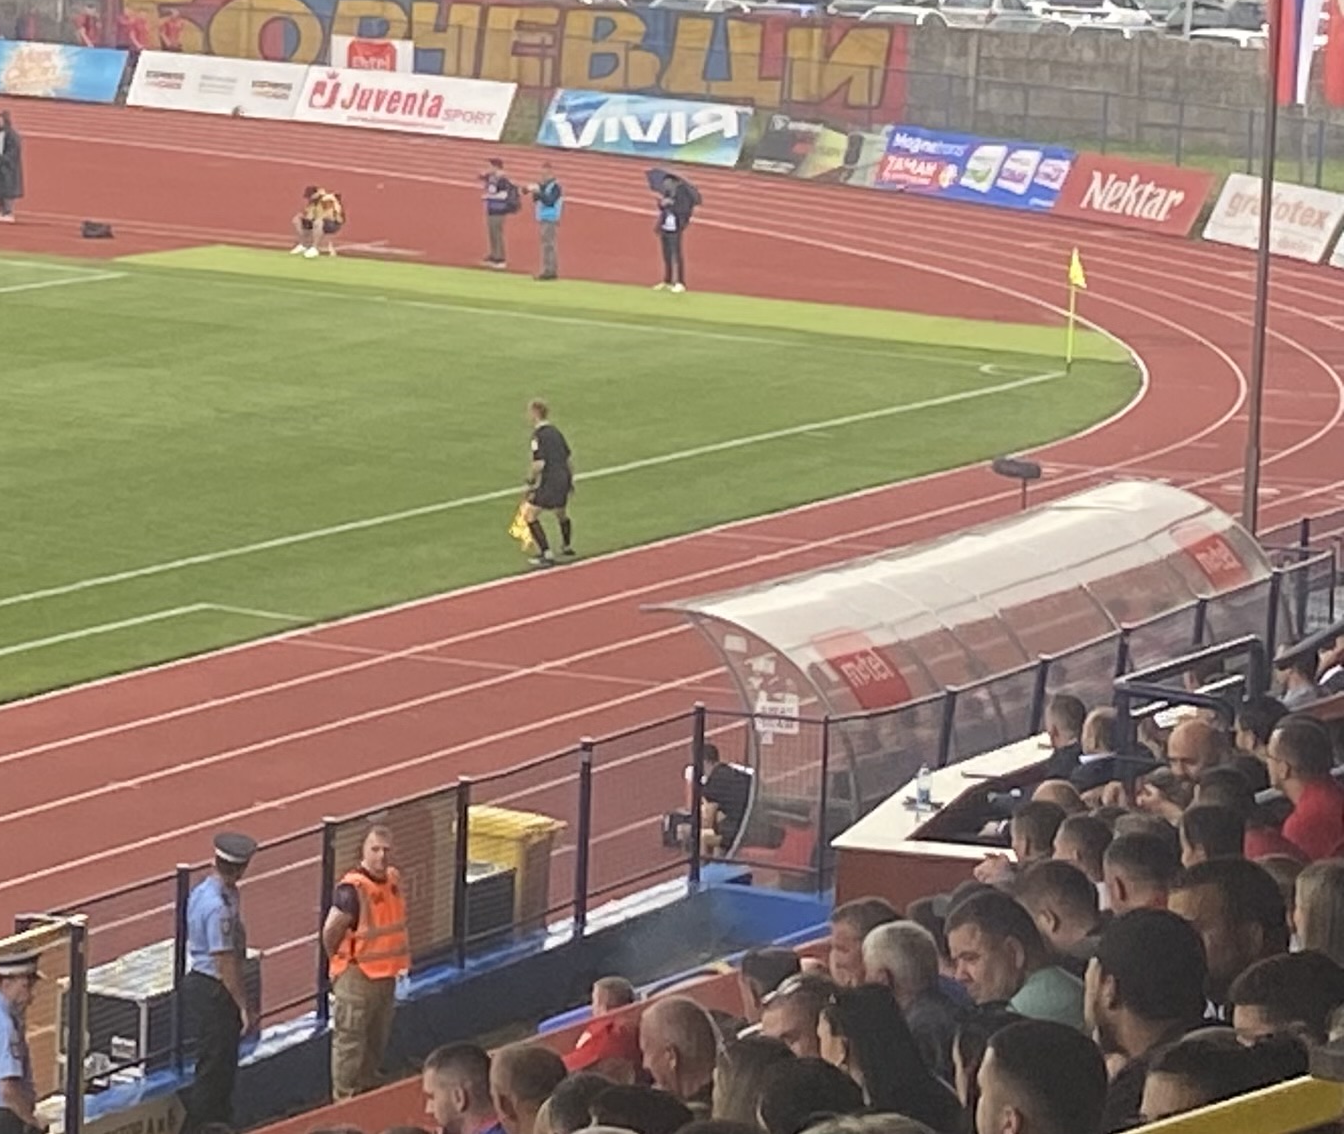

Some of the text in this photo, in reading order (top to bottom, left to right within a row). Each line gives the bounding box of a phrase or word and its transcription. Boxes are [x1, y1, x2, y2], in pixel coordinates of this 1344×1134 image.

[341, 82, 445, 119] Juventa
[441, 107, 498, 126] SPORT
[1079, 169, 1185, 222] Nektar
[1226, 191, 1332, 231] graotex
